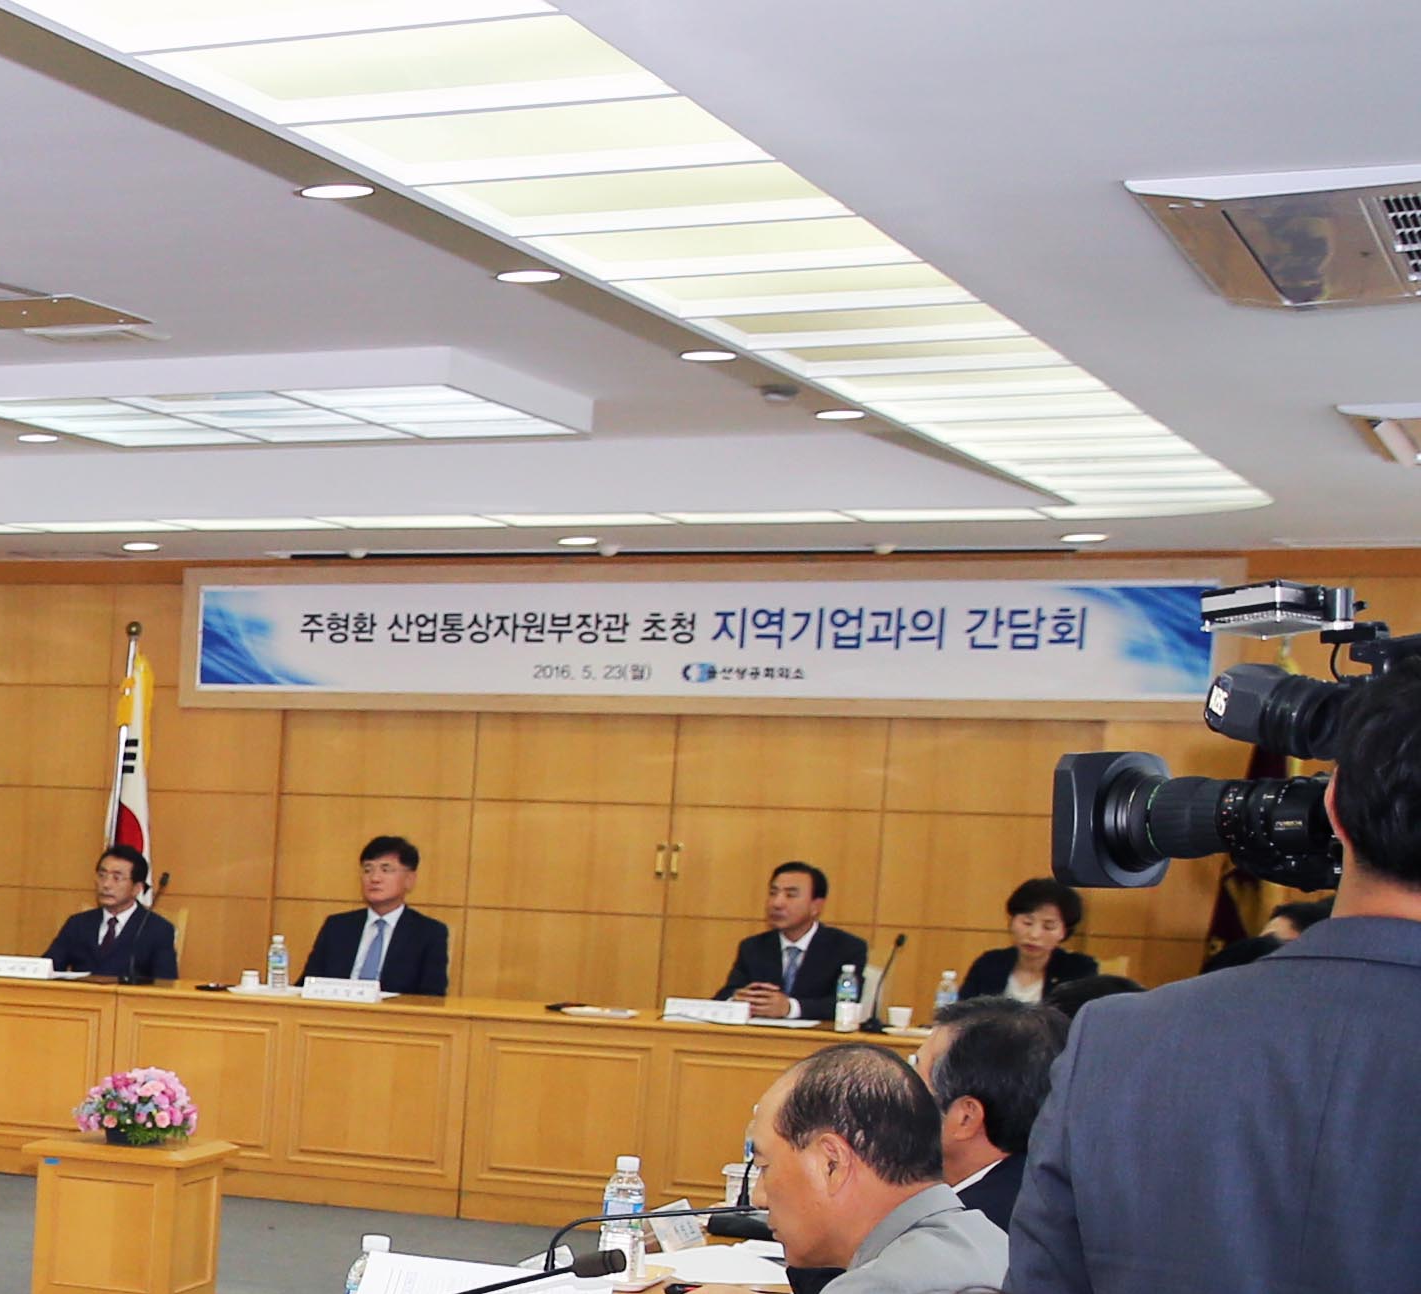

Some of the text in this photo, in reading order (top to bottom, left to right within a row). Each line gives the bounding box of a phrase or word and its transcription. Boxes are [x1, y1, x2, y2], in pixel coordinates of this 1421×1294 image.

[299, 605, 1088, 650] 주형환 산업통상자원부장관 초청 지역기업과의 간담회
[532, 663, 653, 681] 2016. 5. 23(월)
